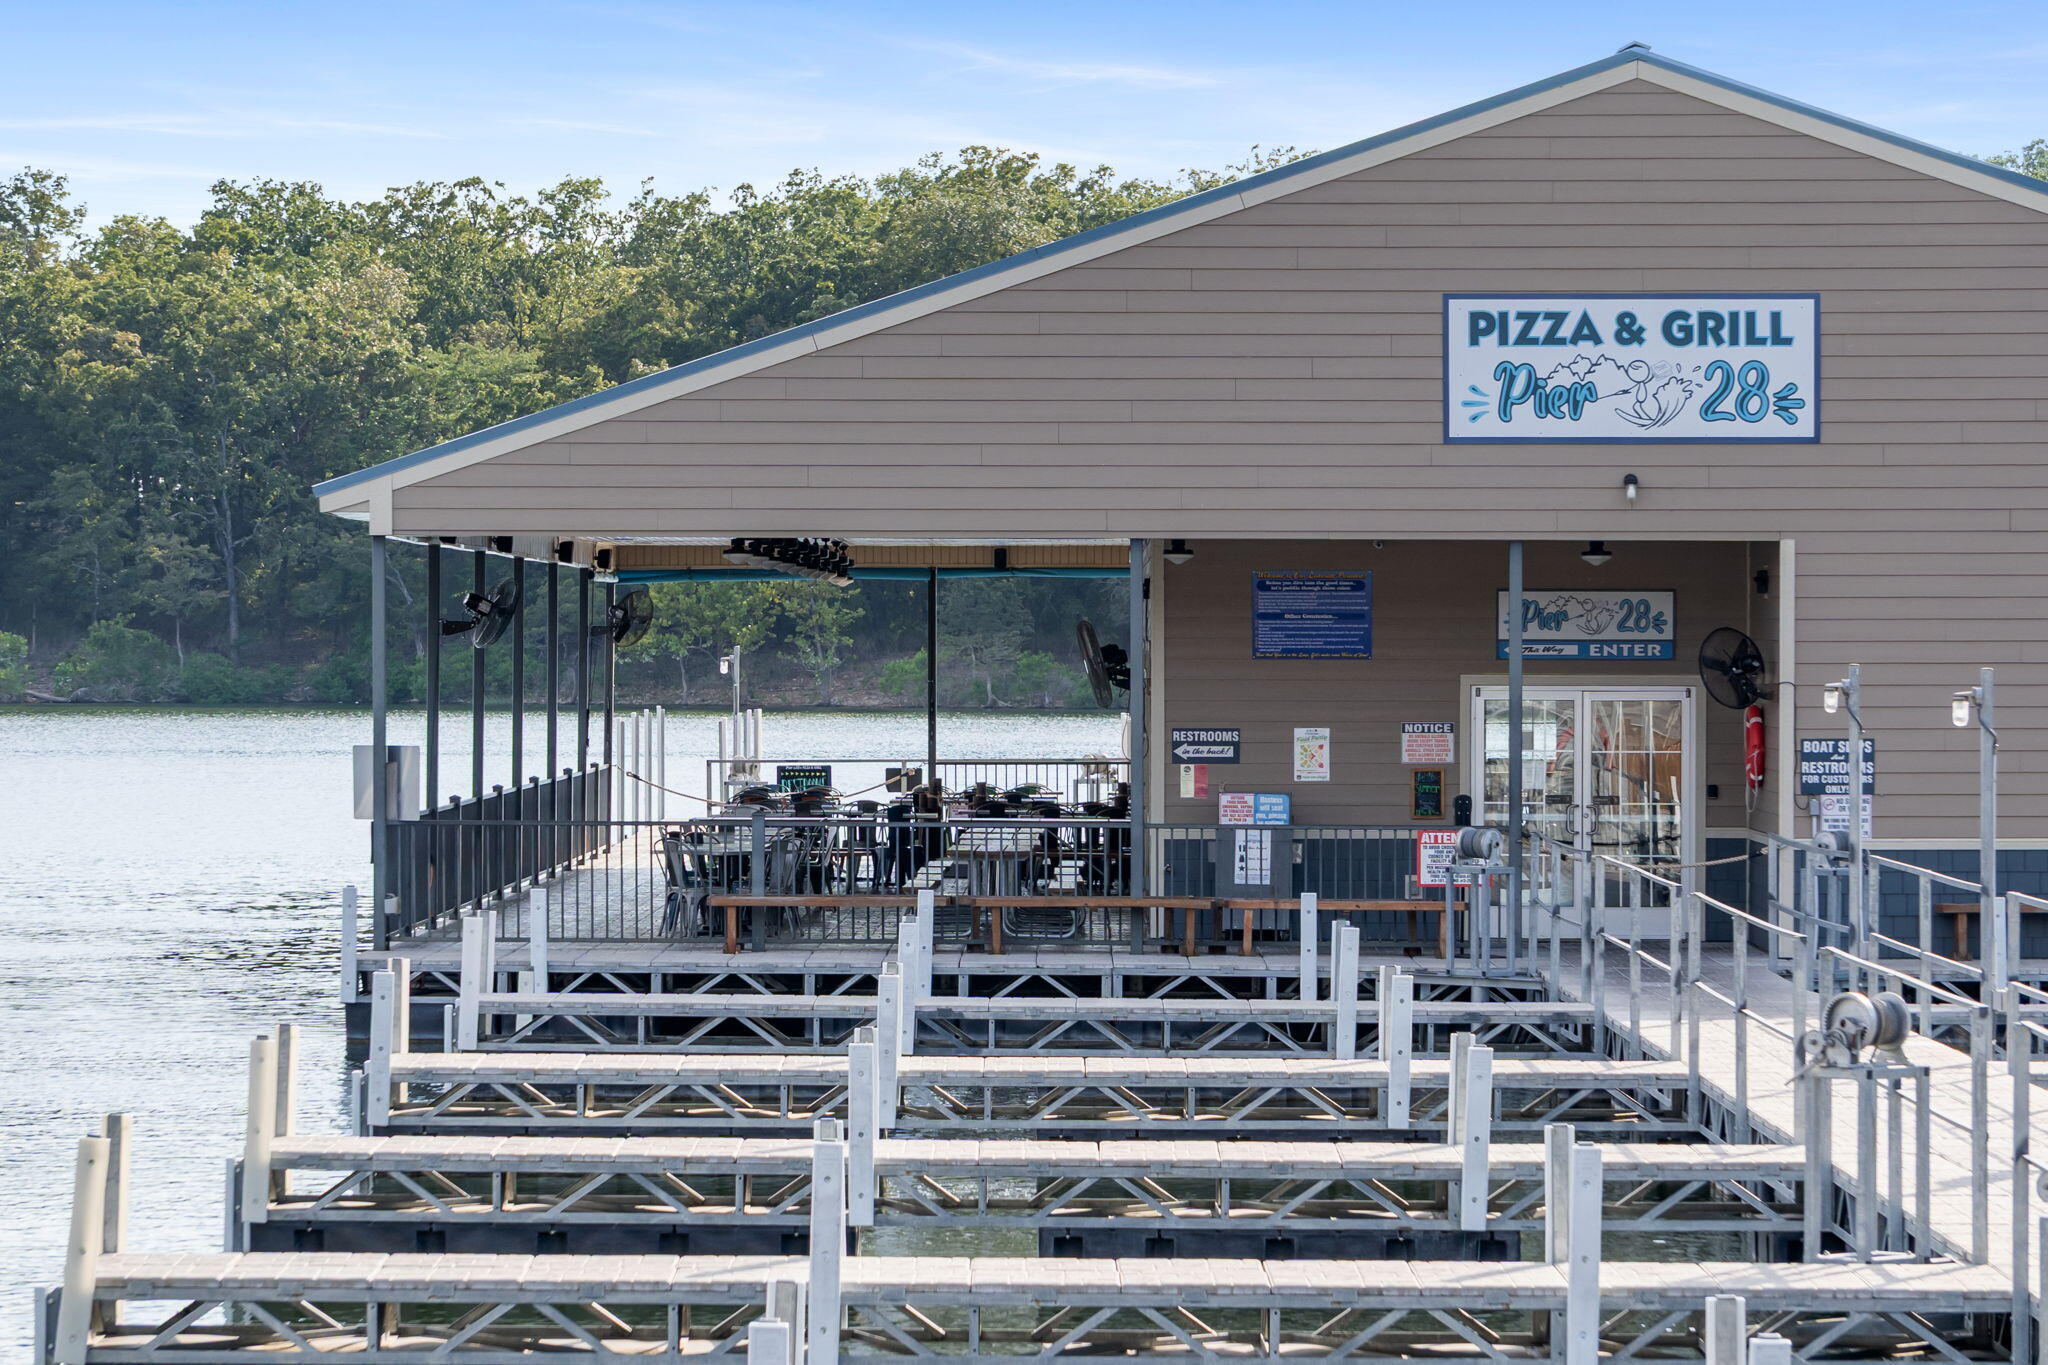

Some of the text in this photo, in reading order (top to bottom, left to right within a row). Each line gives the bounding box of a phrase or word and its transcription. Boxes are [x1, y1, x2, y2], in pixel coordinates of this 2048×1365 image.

[1468, 309, 1794, 347] PIZZA & GRILL
[1493, 360, 1770, 423] Pier 28
[1522, 599, 1651, 632] Pier 28
[1543, 646, 1564, 654] Way
[1590, 644, 1661, 656] ENTER
[1405, 724, 1451, 732] NOTICE
[1173, 731, 1239, 741] RESTROOMS
[1803, 741, 1872, 753] BOAT SLS
[1802, 762, 1874, 774] RESTROS
[1802, 775, 1819, 783] FOR
[1421, 832, 1457, 843] ATTEN
